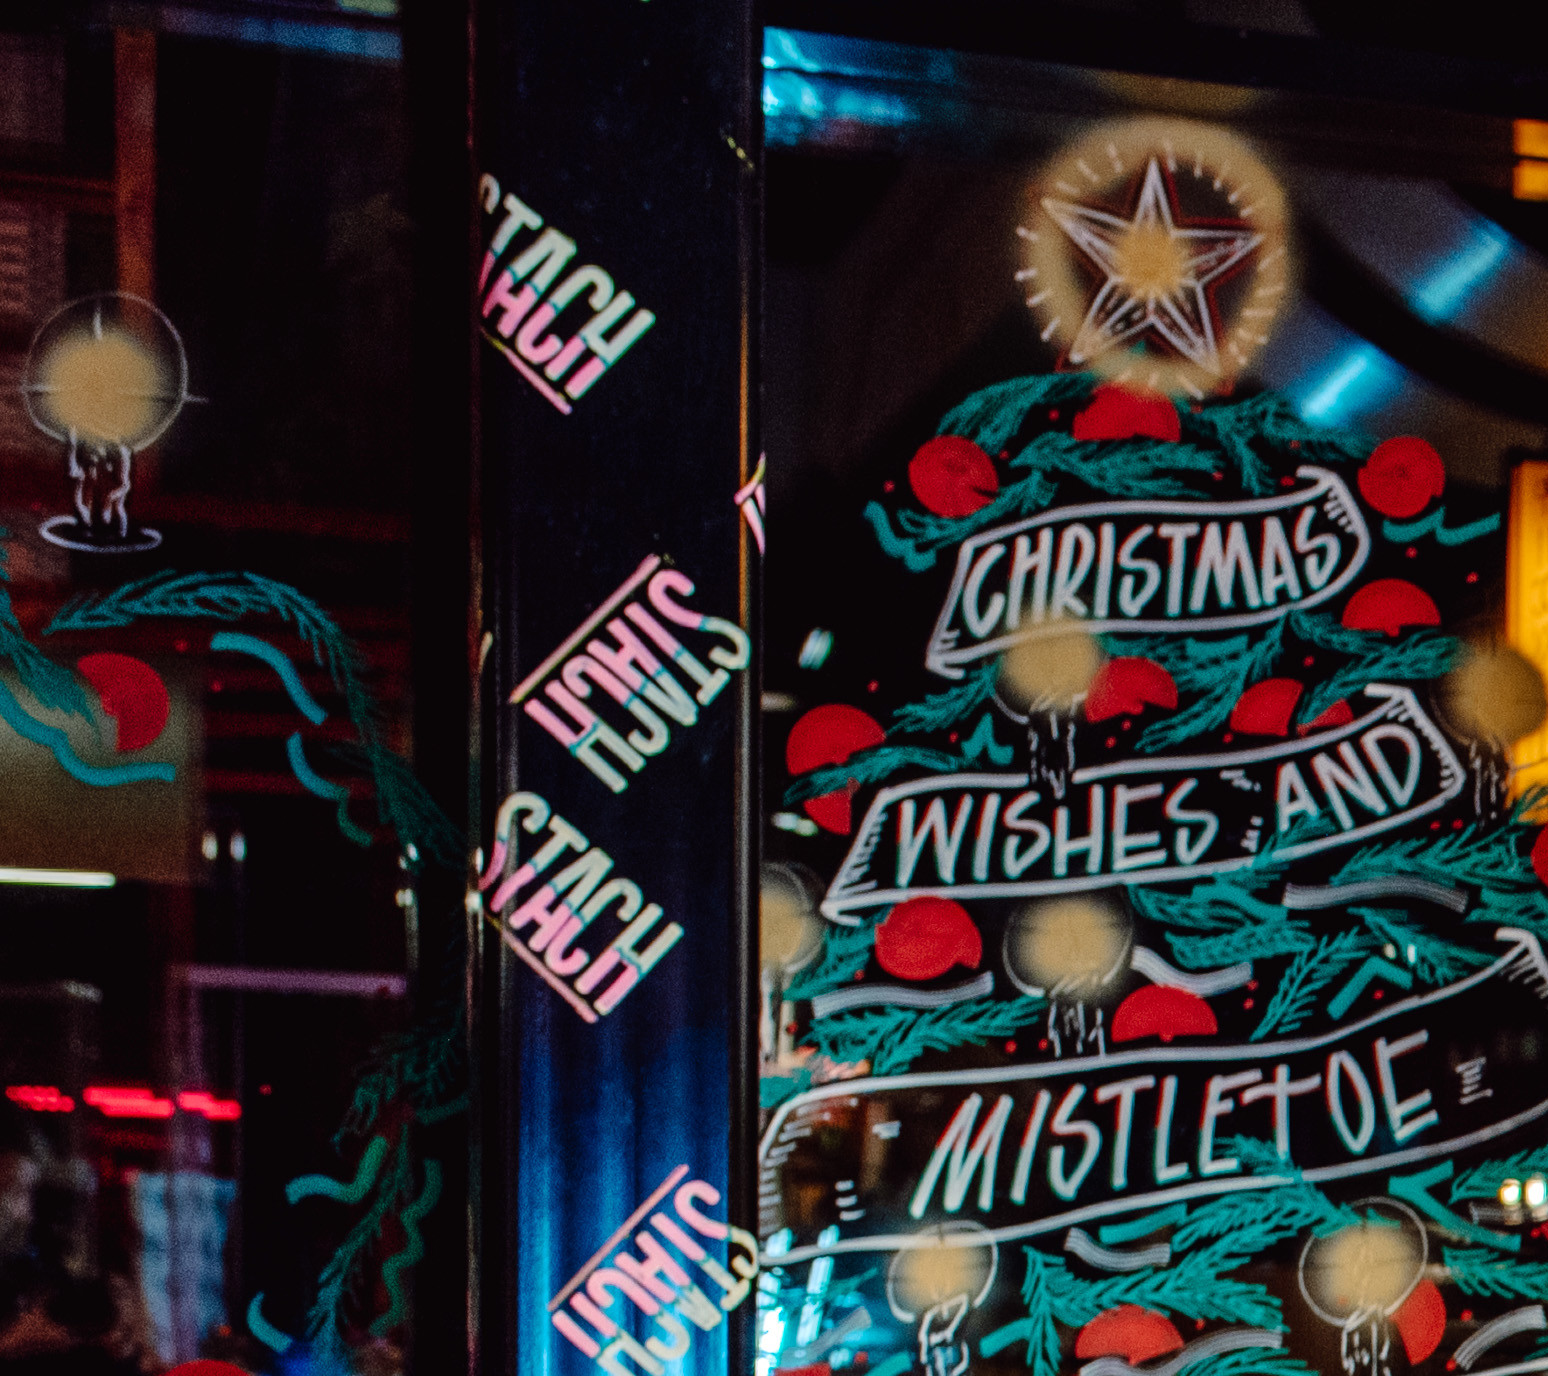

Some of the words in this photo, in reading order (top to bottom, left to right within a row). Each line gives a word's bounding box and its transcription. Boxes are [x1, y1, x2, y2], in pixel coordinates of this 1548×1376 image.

[961, 504, 1340, 638] CHRISTMAS
[524, 568, 751, 793] STACH
[897, 775, 1219, 886] WISHES
[1275, 723, 1421, 832] AND
[479, 792, 684, 1016] STACH
[912, 1031, 1438, 1216] MISTLETOE
